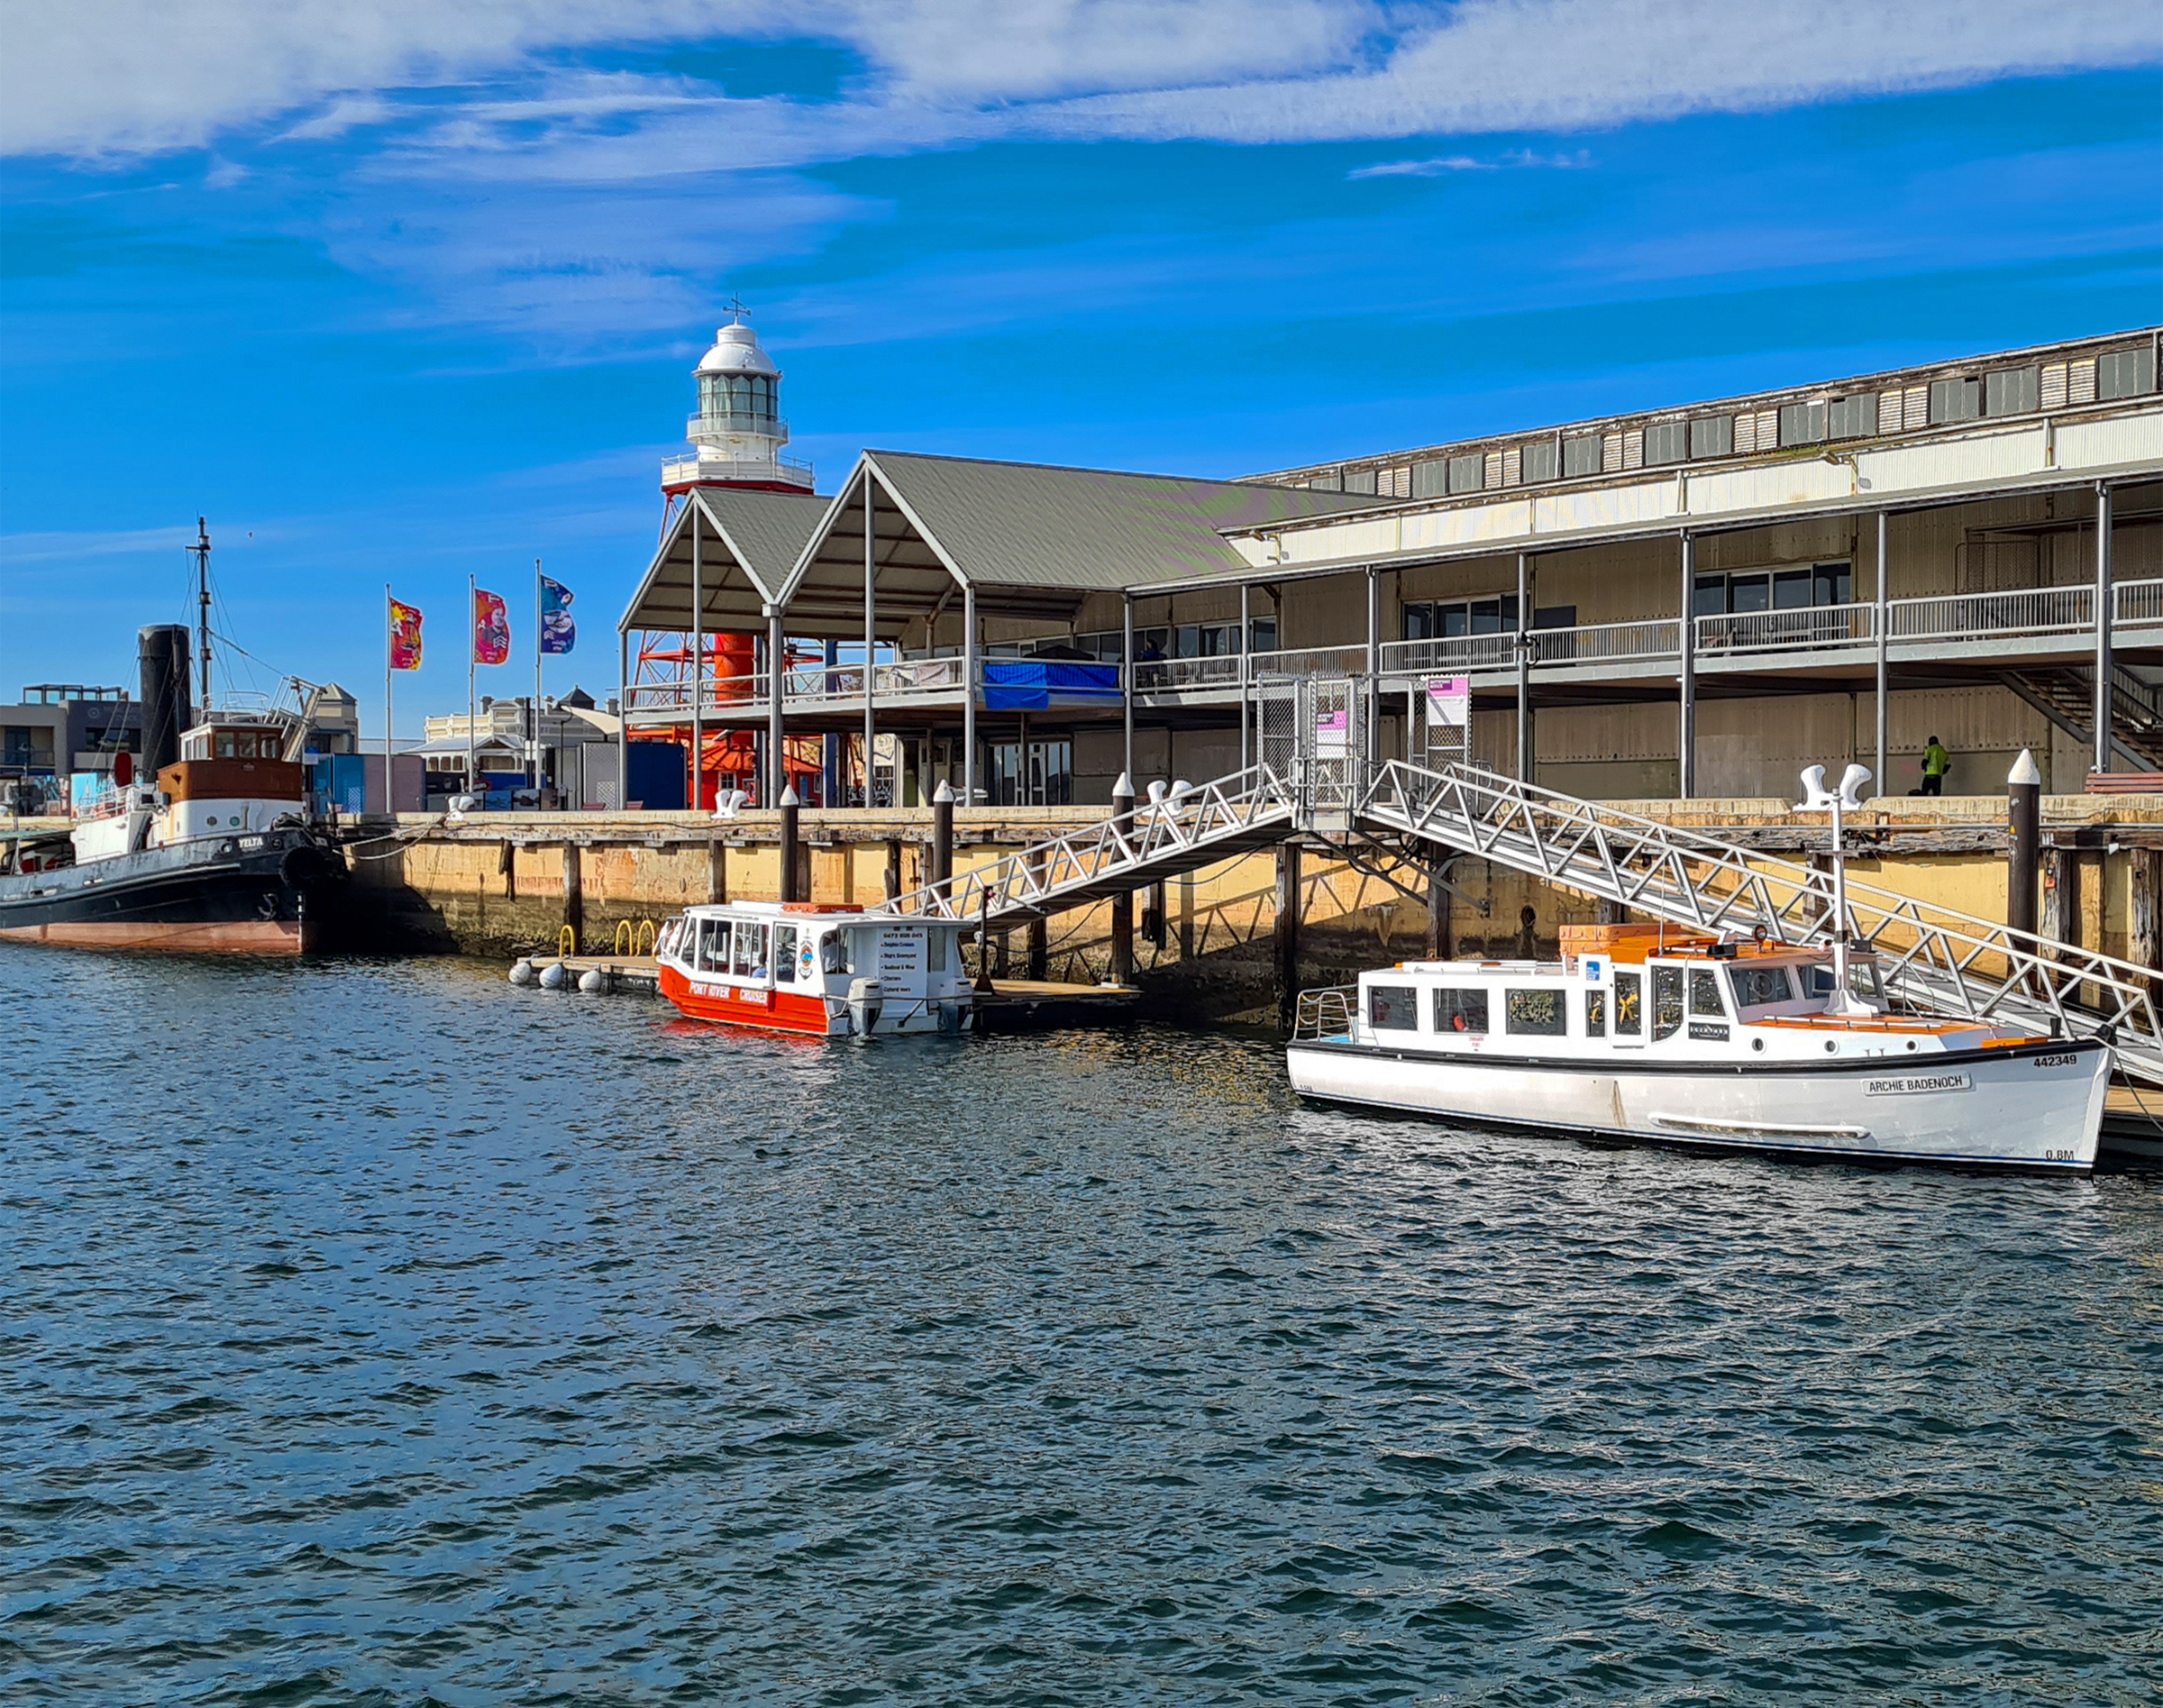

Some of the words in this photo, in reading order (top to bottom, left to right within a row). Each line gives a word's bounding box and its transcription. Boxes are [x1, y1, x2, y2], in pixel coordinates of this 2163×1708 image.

[238, 836, 264, 848] YELTA
[689, 982, 708, 997] PORT
[708, 984, 731, 999] RIVER
[740, 989, 768, 1005] CRUISES
[2033, 1055, 2077, 1067] 442349
[1869, 1081, 1905, 1092] ARCHIE
[1907, 1075, 1963, 1091] BADENOCH
[2046, 1150, 2075, 1161] 0.8M
